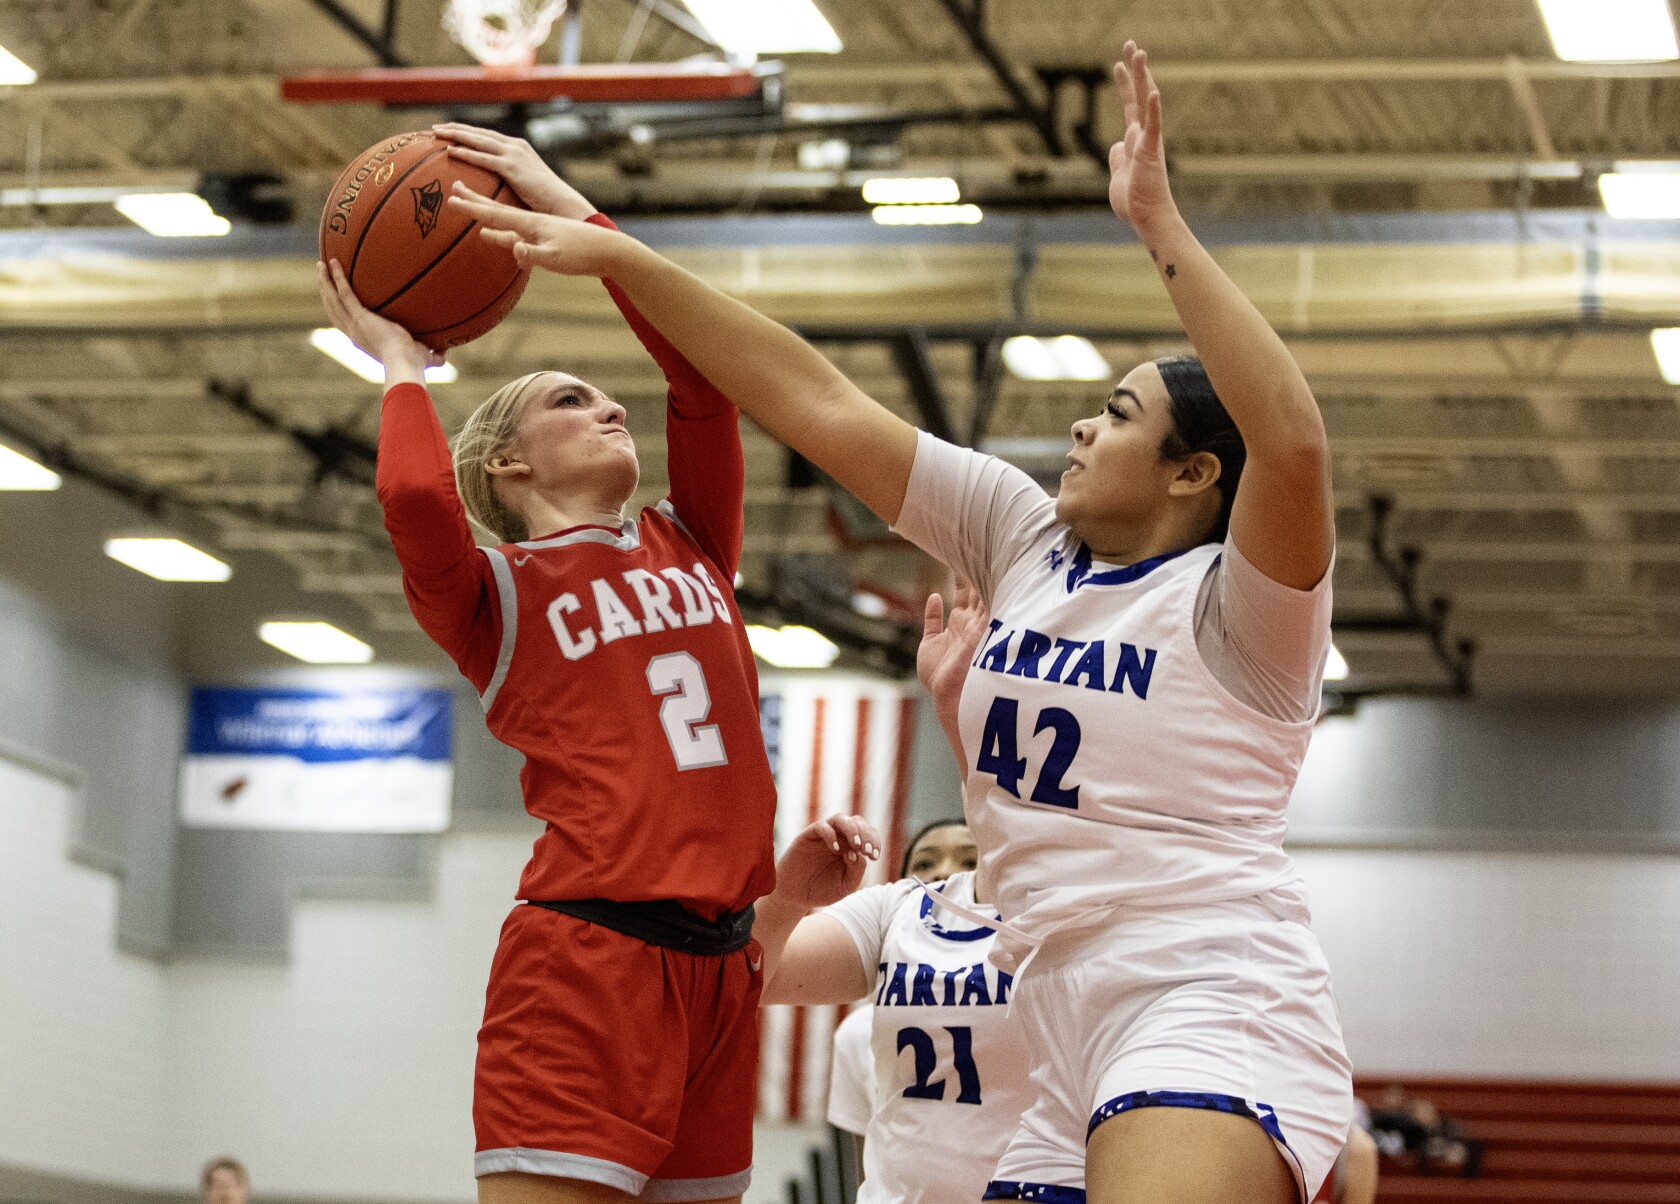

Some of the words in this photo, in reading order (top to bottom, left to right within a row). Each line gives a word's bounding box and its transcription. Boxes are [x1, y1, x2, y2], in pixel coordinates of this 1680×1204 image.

[546, 562, 732, 661] CARDS
[645, 650, 729, 772] 2
[976, 696, 1082, 810] 42
[897, 1026, 982, 1105] 21
